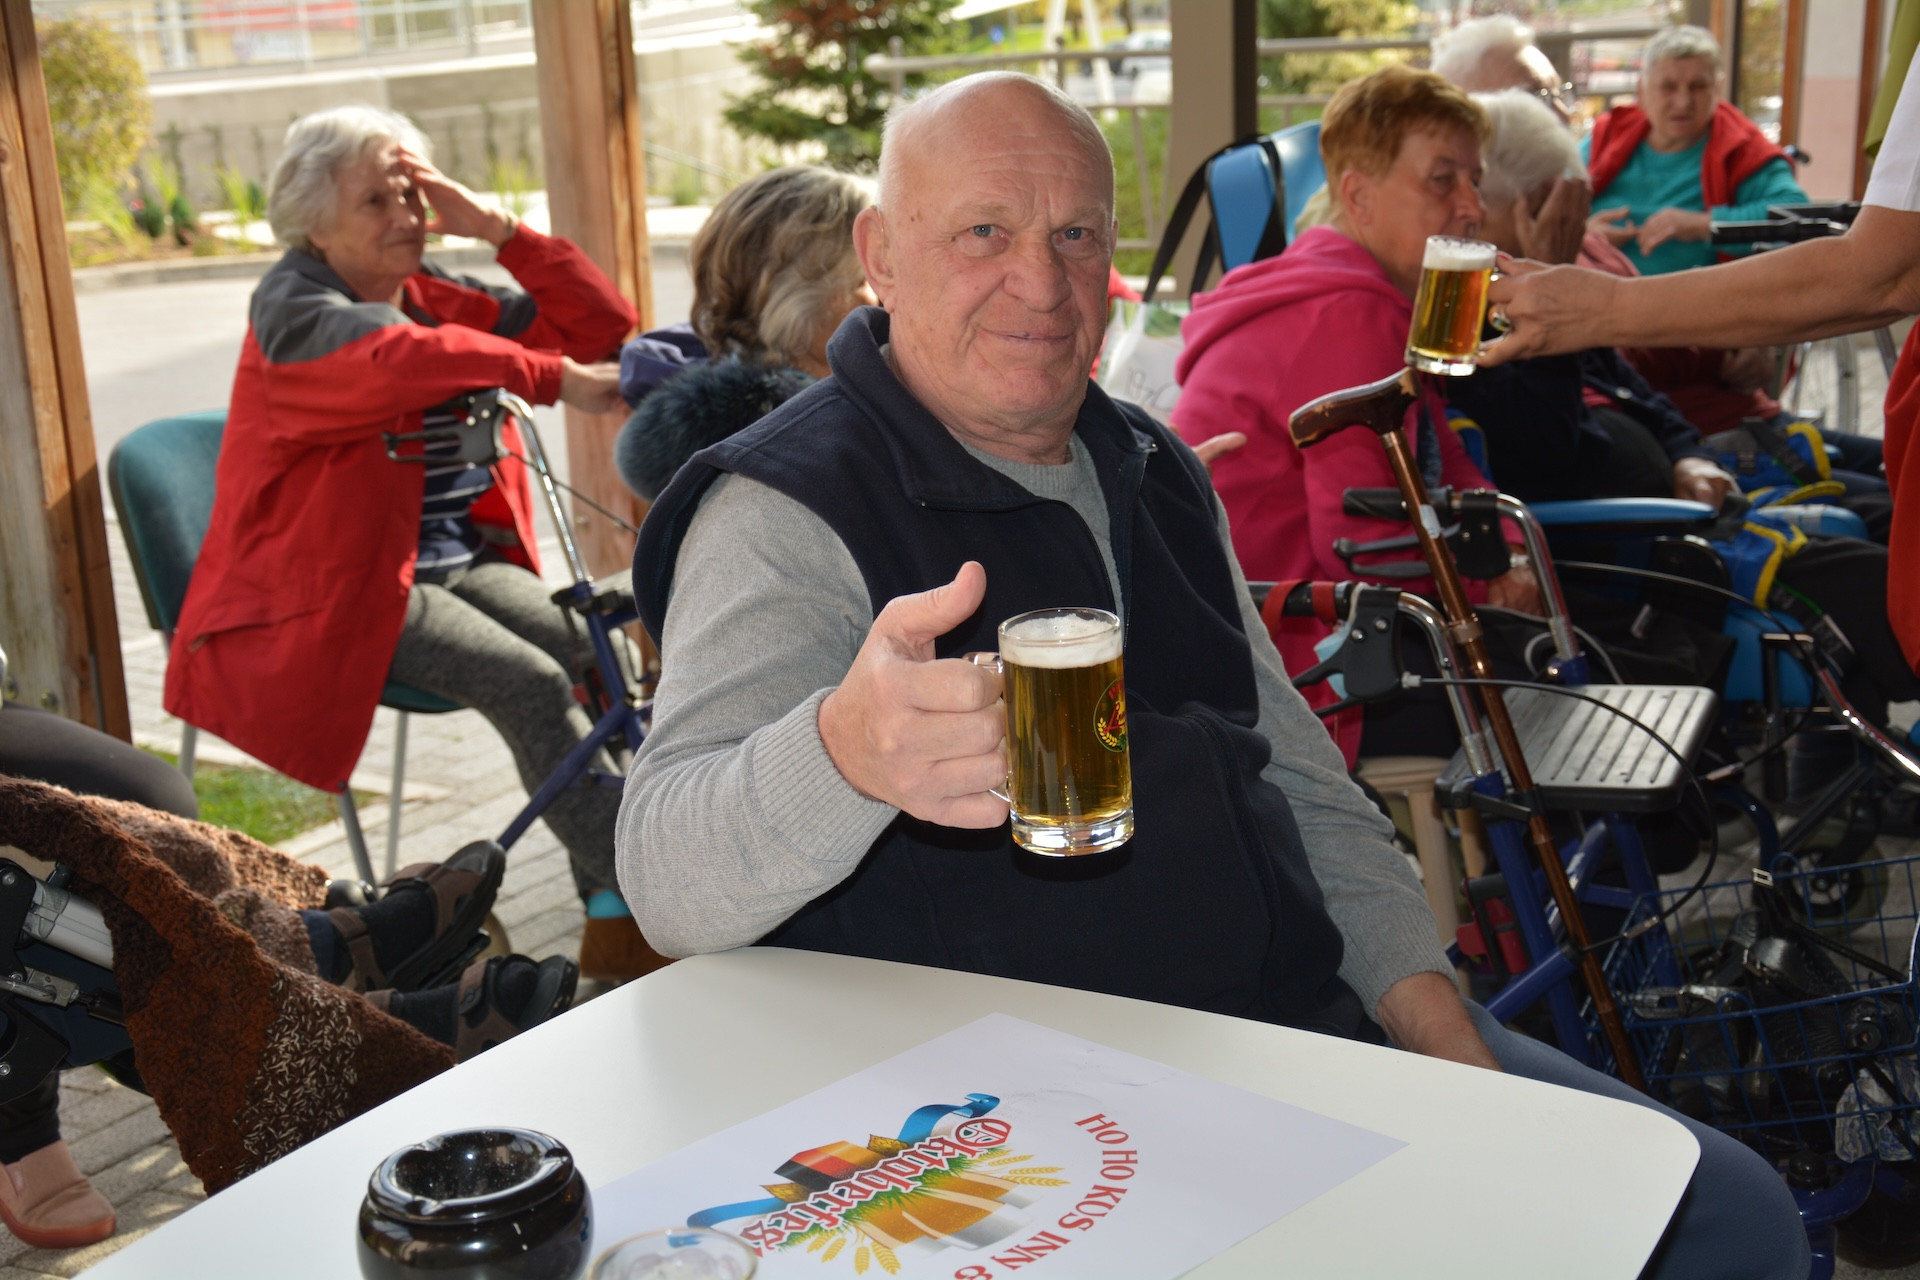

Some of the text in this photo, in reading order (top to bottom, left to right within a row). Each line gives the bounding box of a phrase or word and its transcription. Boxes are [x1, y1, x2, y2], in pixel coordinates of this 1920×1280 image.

[1073, 1113, 1129, 1145] HO
[1100, 1149, 1138, 1181] HO
[739, 1118, 1012, 1258] Oktoberfes
[1057, 1184, 1128, 1232] KUS
[989, 1230, 1072, 1271] INN
